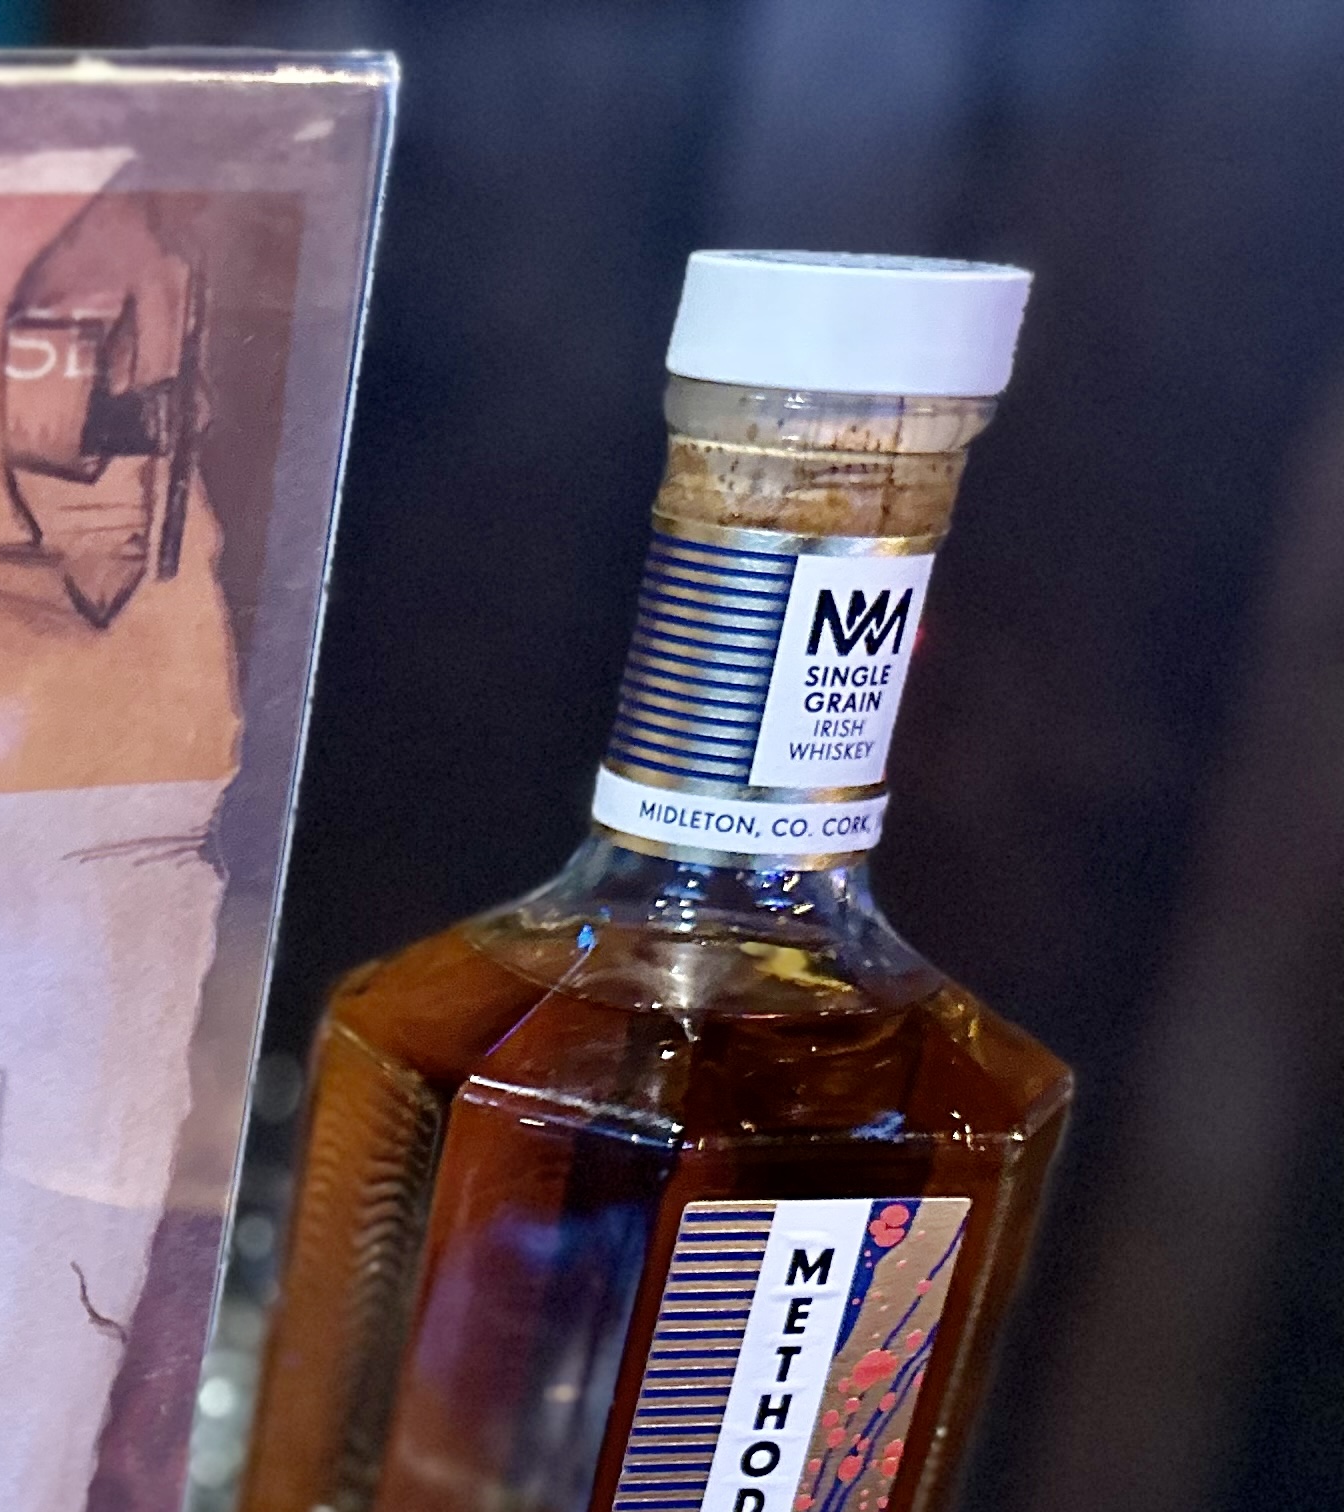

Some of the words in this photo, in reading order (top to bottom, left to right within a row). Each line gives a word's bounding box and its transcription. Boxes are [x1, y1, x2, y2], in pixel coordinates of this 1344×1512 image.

[805, 665, 892, 688] SINGLE
[804, 690, 883, 714] GRAIN
[813, 718, 865, 737] IRISH
[789, 740, 875, 761] WHISKEY
[639, 799, 762, 839] MIDLETON,
[771, 817, 813, 838] CO.
